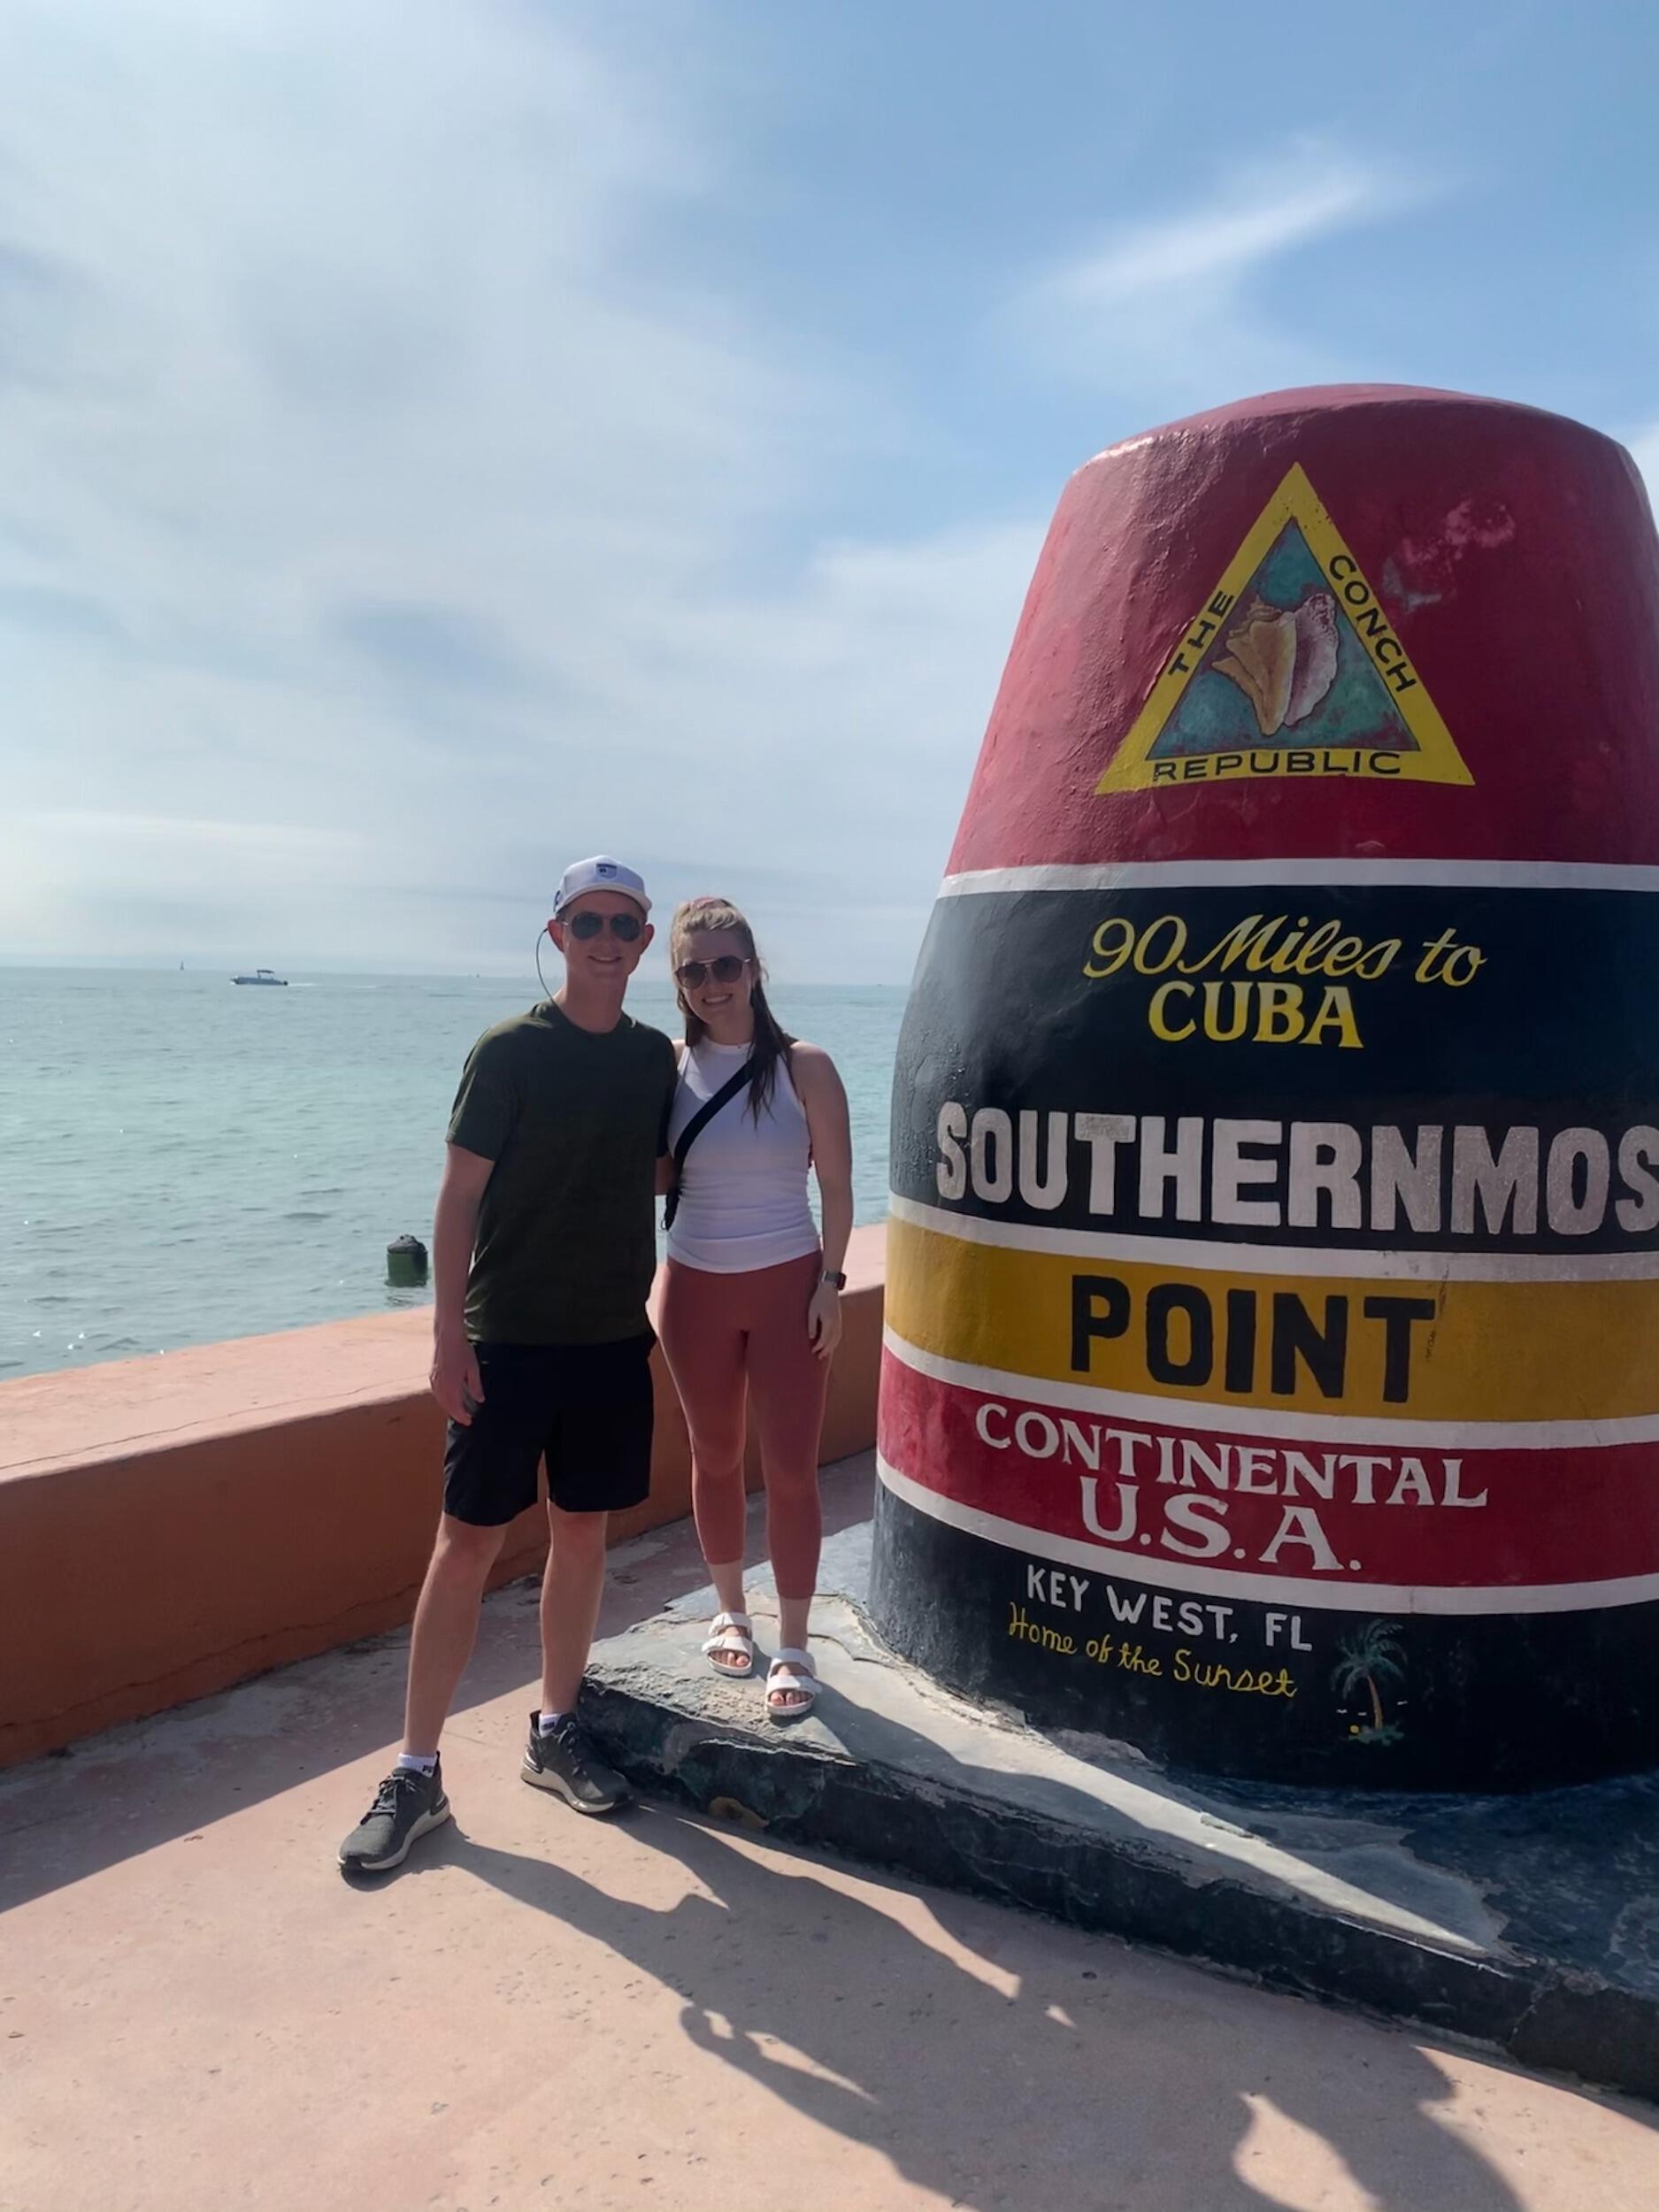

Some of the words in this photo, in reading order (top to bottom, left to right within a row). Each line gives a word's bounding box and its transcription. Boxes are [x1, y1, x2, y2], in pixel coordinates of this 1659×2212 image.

[1169, 590, 1235, 676] THE
[1329, 555, 1417, 693] CONCH
[1153, 750, 1402, 781] REPUBLIC
[1082, 915, 1187, 979] 90
[1177, 914, 1402, 979] Miles
[1415, 927, 1487, 987] to
[1148, 982, 1364, 1048] CUBA
[935, 1101, 1659, 1235] SOUTHERNMOS
[1071, 1274, 1436, 1403] POINT
[975, 1403, 1488, 1508] CONTINENTAL
[1079, 1476, 1363, 1571] U.S.A.
[1008, 1602, 1078, 1655] Home
[1087, 1633, 1112, 1663] of
[1118, 1643, 1163, 1677] the
[1173, 1648, 1298, 1698] Sunset
[1026, 1563, 1089, 1612] KEY
[1106, 1585, 1238, 1643] WEST,
[1265, 1613, 1312, 1651] FL
